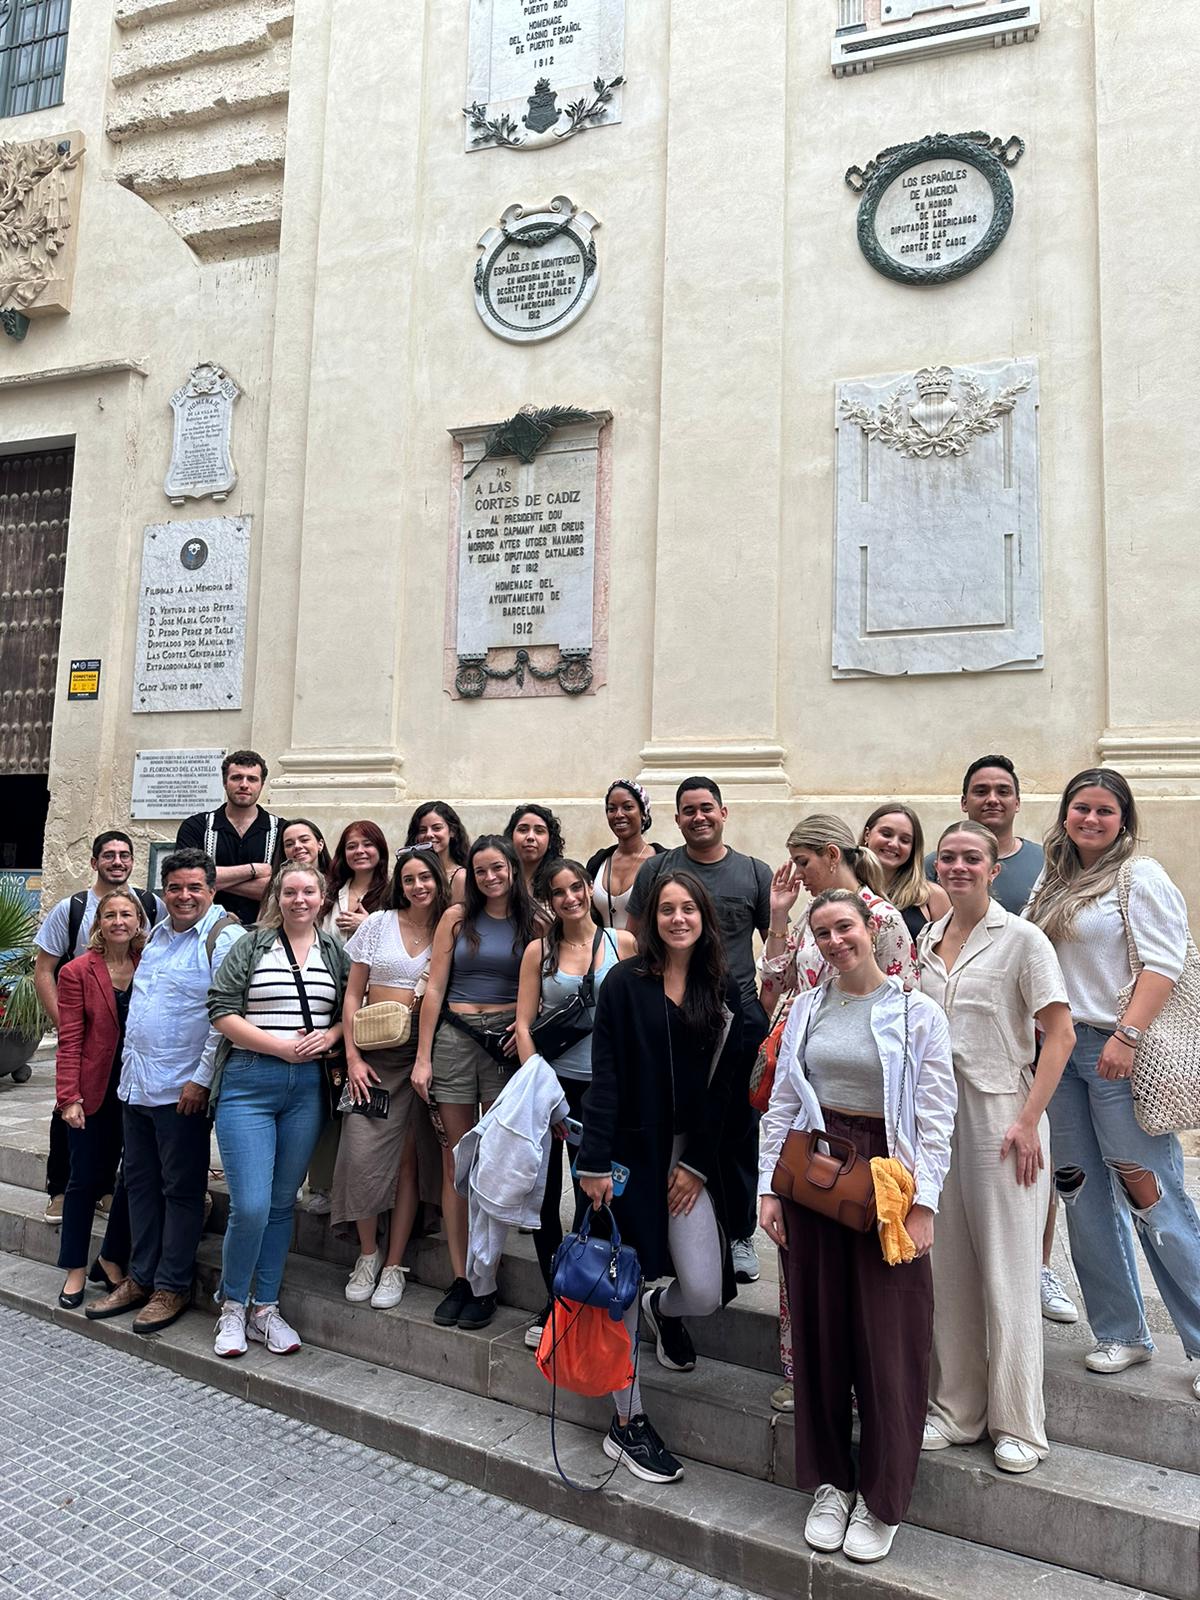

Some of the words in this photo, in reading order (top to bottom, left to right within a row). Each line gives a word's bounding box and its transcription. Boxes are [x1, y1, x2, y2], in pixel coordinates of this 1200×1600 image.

[524, 3, 548, 15] PUERTO
[553, 0, 568, 9] RICO
[509, 36, 521, 46] DEL
[526, 29, 548, 42] CASINO
[553, 22, 582, 36] ESPAÑOL
[516, 45, 524, 55] DE
[529, 39, 554, 52] PUERTO
[559, 35, 574, 45] RICO
[902, 177, 917, 188] LOS
[921, 169, 968, 185] ESPAÑOLES
[910, 190, 920, 200] DE
[924, 184, 958, 198] AMERICA
[915, 202, 925, 211] EN
[929, 198, 952, 209] HONOR
[920, 211, 928, 220] DE
[933, 209, 947, 218] LOS
[890, 222, 929, 235] DIPUTADOS
[933, 214, 977, 228] AMERICANOS
[920, 232, 929, 241] DE
[933, 230, 947, 239] LAS
[900, 242, 928, 254] CORTES
[932, 240, 941, 249] DE
[945, 236, 967, 247] CADIZ
[507, 252, 519, 262] LOS
[926, 252, 941, 261] 1912
[494, 262, 529, 276] ESPAÑOLES
[531, 261, 540, 271] DE
[541, 254, 580, 269] MONTEVIDEO
[543, 272, 550, 280] DE
[553, 270, 564, 278] LOS
[497, 284, 526, 296] DECRETOS
[528, 283, 536, 291] DE
[568, 276, 576, 284] DE
[528, 292, 534, 300] DE
[537, 286, 572, 299] ESPAÑOLES
[521, 298, 556, 310] AMERICANOS
[528, 310, 540, 320] 1912
[475, 484, 482, 495] A
[488, 481, 512, 494] LAS
[475, 496, 519, 511] CORTES
[525, 494, 542, 507] DE
[546, 490, 581, 505] CADIZ
[490, 515, 499, 525] AL
[504, 512, 544, 524] PRESIDENTE
[548, 510, 563, 520] DOU
[467, 530, 472, 539] A
[504, 525, 534, 536] CAPMANY
[539, 523, 557, 534] ANER
[468, 541, 495, 552] MORROS
[499, 539, 520, 549] AYTES
[552, 534, 584, 545] NAVARRO
[468, 555, 473, 564] Y
[478, 553, 500, 564] DEMAS
[504, 550, 540, 562] DIPUTADOS
[545, 547, 584, 559] CATALANES
[511, 564, 520, 574] DE
[526, 563, 538, 572] 1812
[540, 578, 554, 588] DEL
[489, 592, 544, 604] AYUNTAMIENTO
[550, 591, 560, 601] DE
[503, 605, 545, 616] BARCELONA
[513, 622, 533, 634] 1912
[147, 652, 160, 660] LAS
